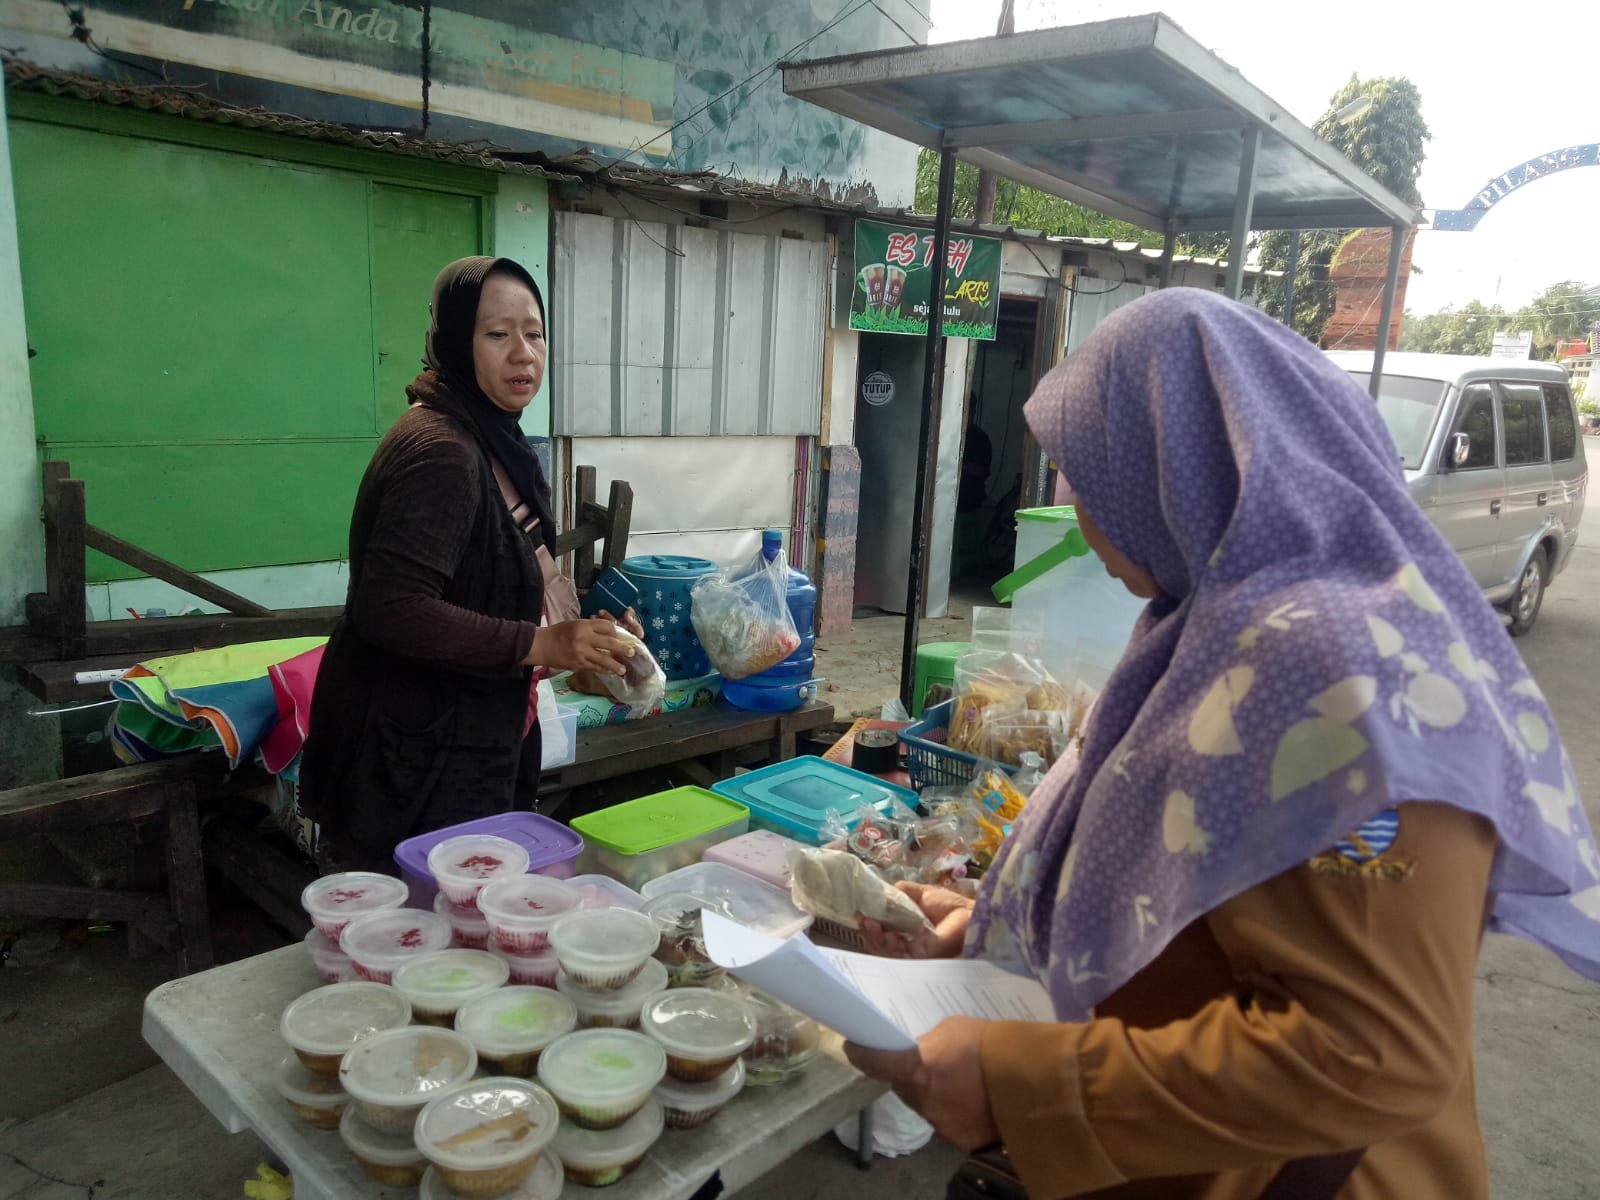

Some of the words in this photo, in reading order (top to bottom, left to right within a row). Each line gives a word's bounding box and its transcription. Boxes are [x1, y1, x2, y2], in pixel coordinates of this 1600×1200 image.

[291, 0, 399, 44] Anda
[886, 232, 918, 266] ES
[864, 383, 892, 394] TUTUP
